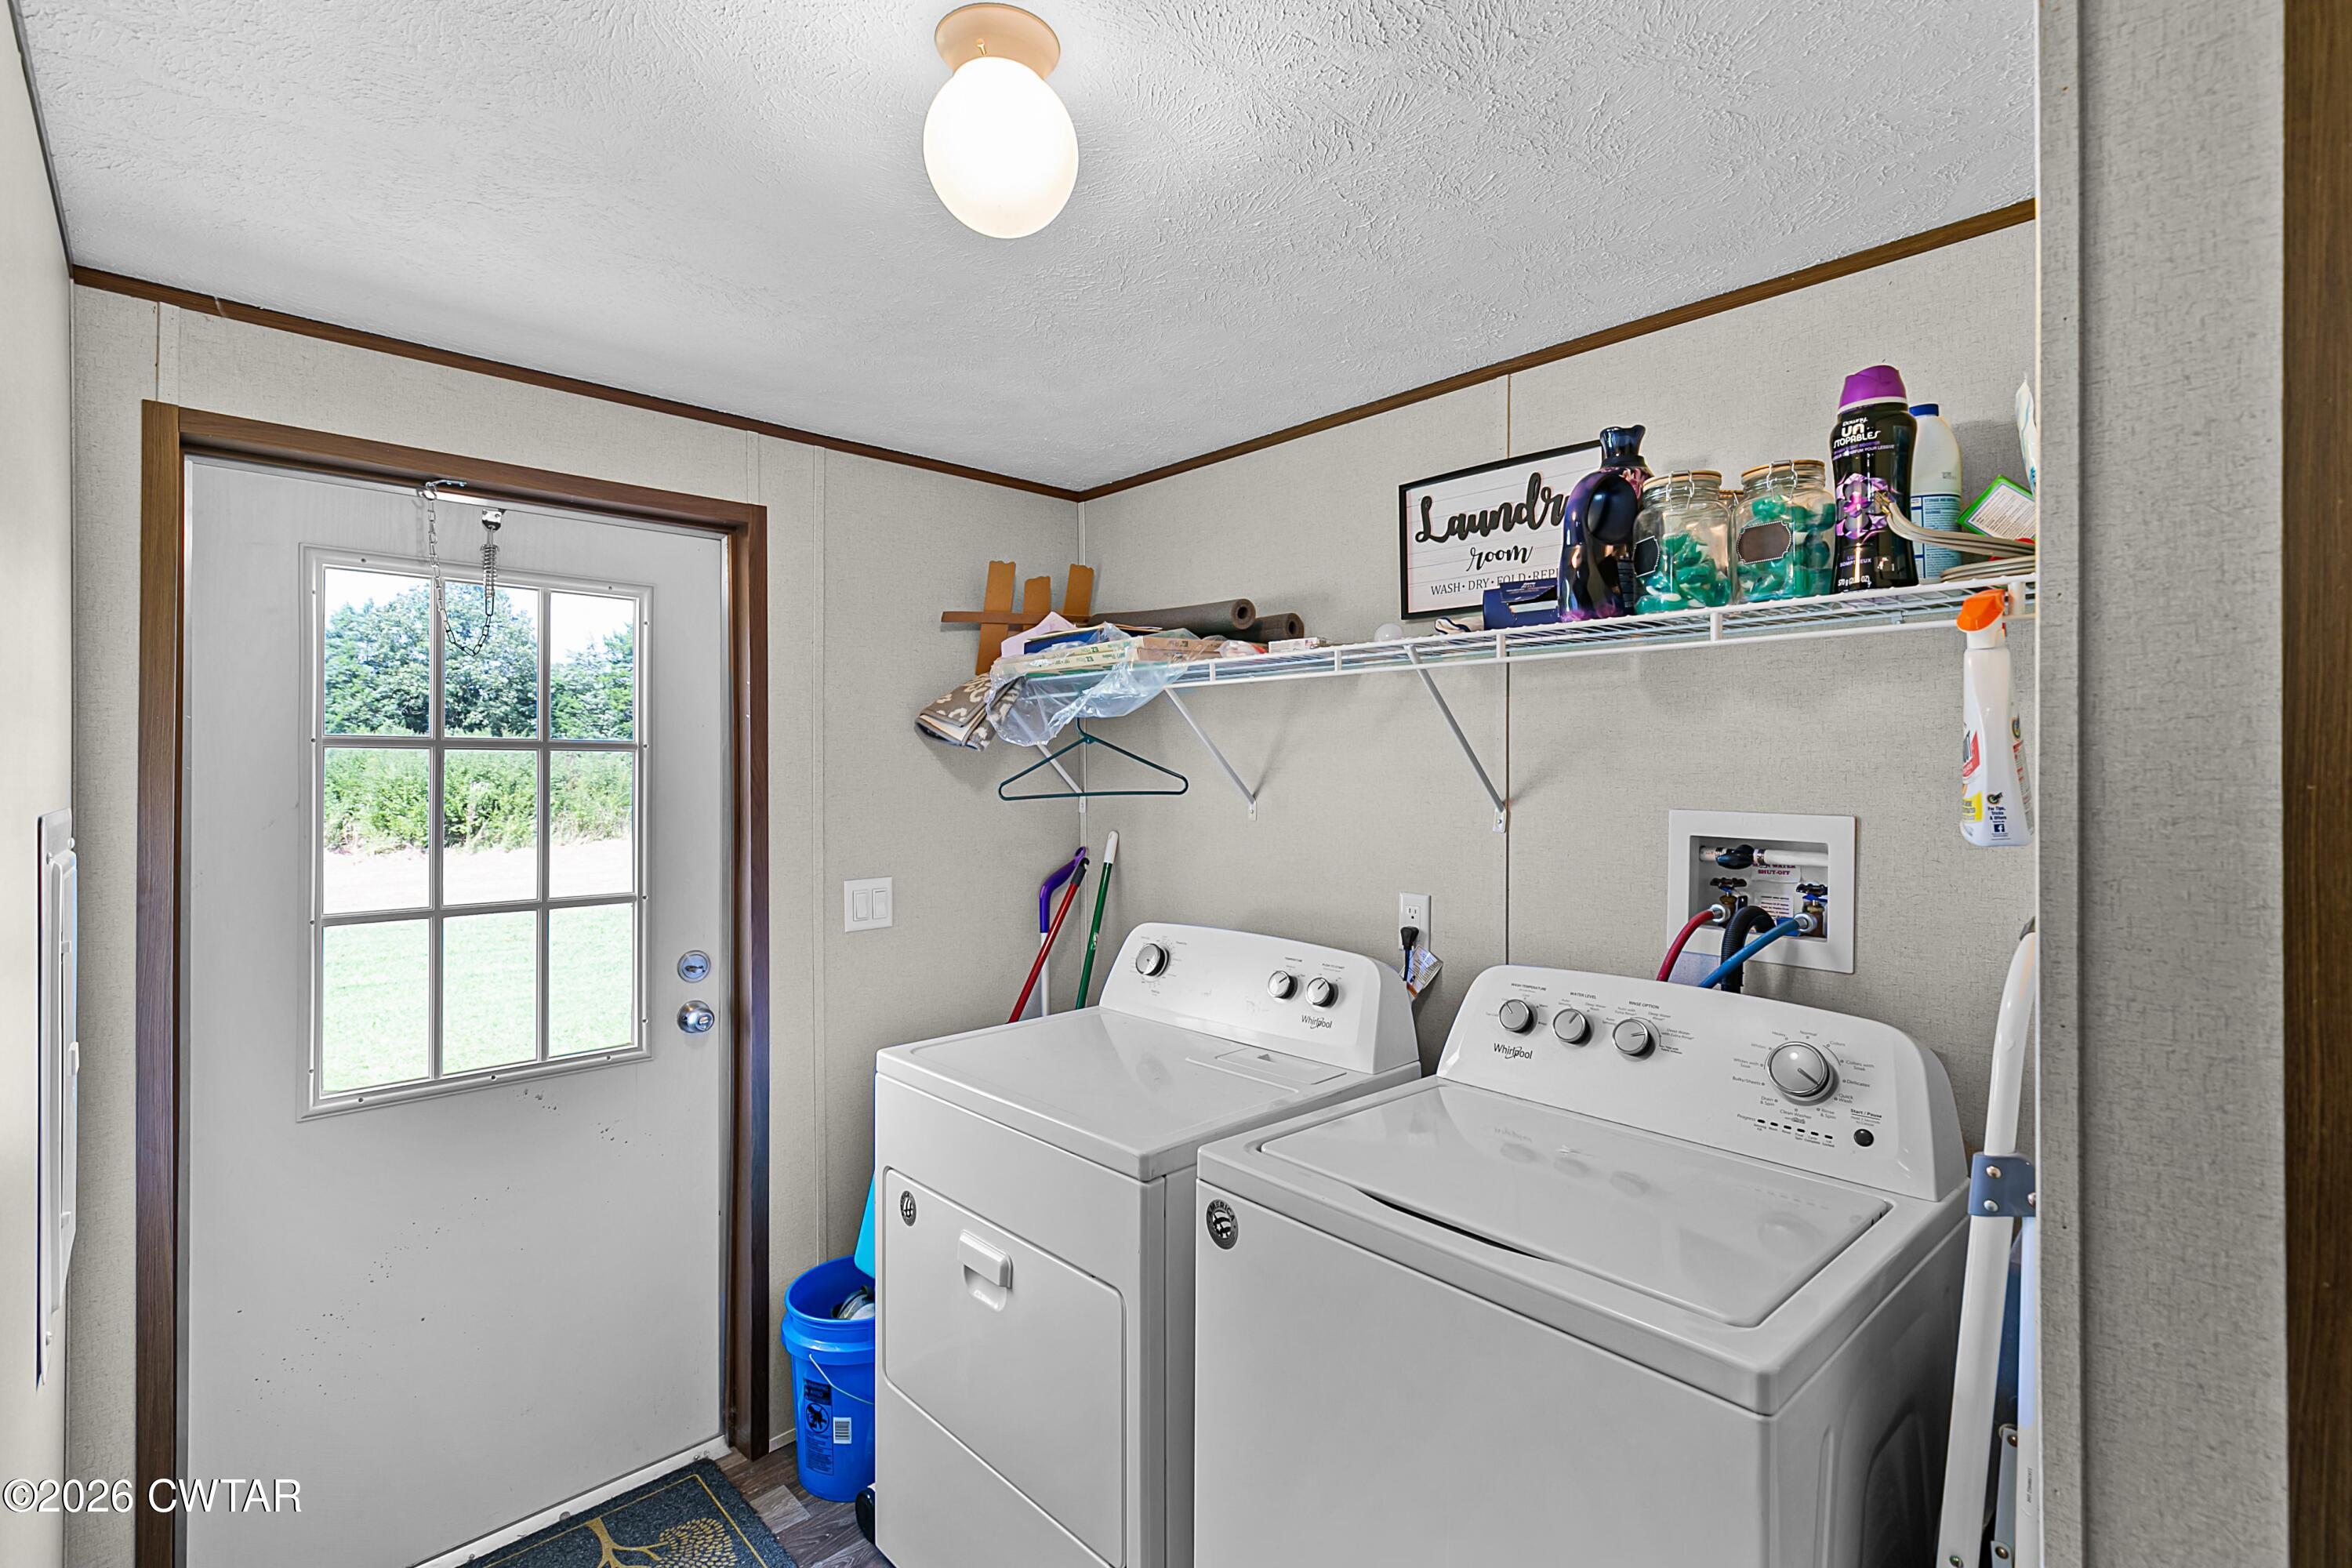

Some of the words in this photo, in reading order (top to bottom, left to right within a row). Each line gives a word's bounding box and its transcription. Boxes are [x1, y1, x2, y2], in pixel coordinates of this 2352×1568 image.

[1414, 471, 1570, 543] Laundr
[1466, 545, 1534, 572] room
[1431, 582, 1460, 595] WASH
[1468, 578, 1490, 590] DRY
[1497, 573, 1526, 586] FOLD
[1533, 568, 1559, 580] REP
[1301, 1014, 1332, 1029] Whirlpool
[1494, 1043, 1533, 1059] Whirlpool
[1207, 1201, 1236, 1221] AMERICA
